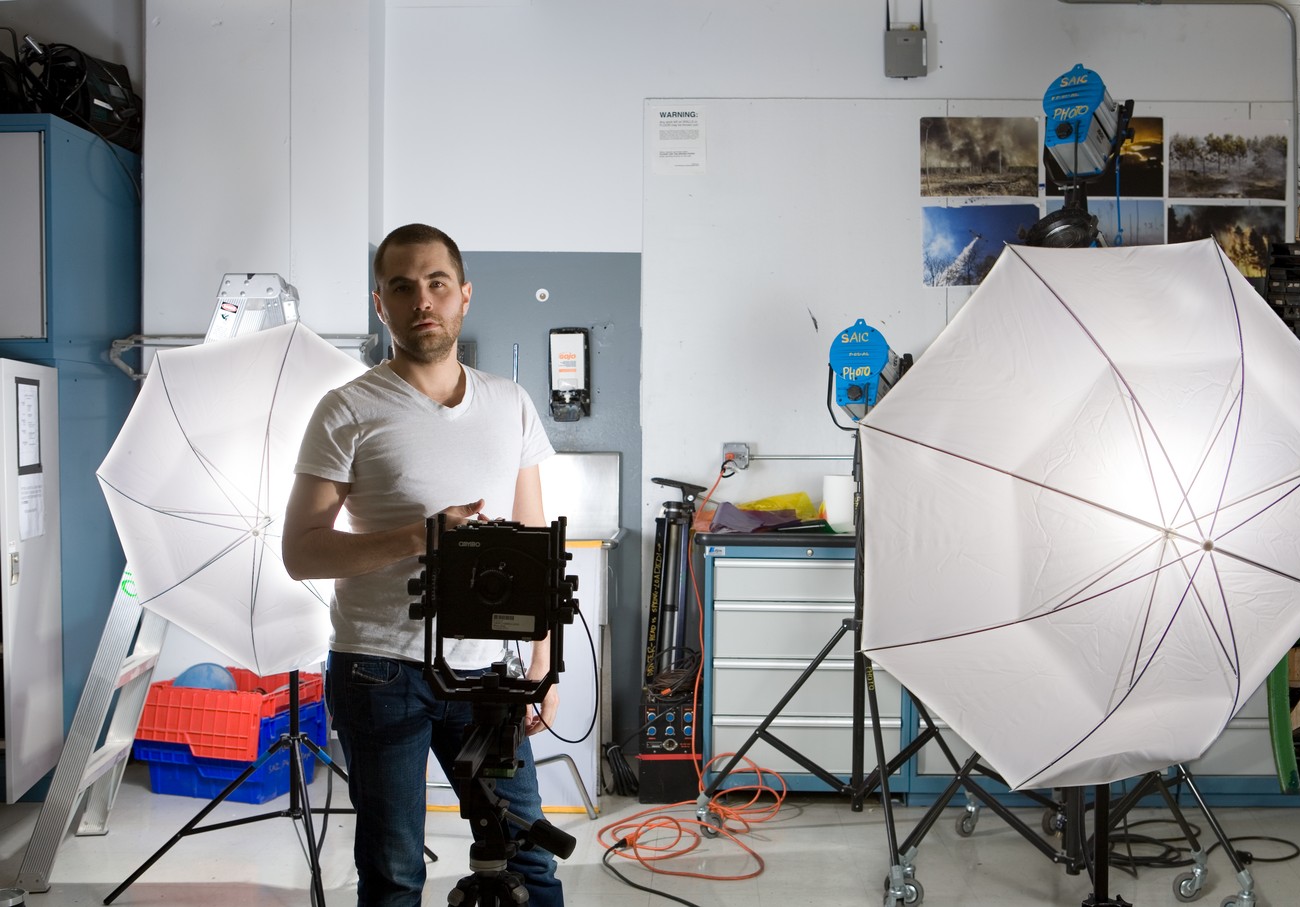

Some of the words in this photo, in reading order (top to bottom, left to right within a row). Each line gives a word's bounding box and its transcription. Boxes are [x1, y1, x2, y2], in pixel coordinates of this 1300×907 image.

[1060, 75, 1088, 87] SAIC
[1053, 105, 1089, 120] PHOTO
[841, 332, 869, 343] SAIC
[842, 366, 871, 381] PHOTO
